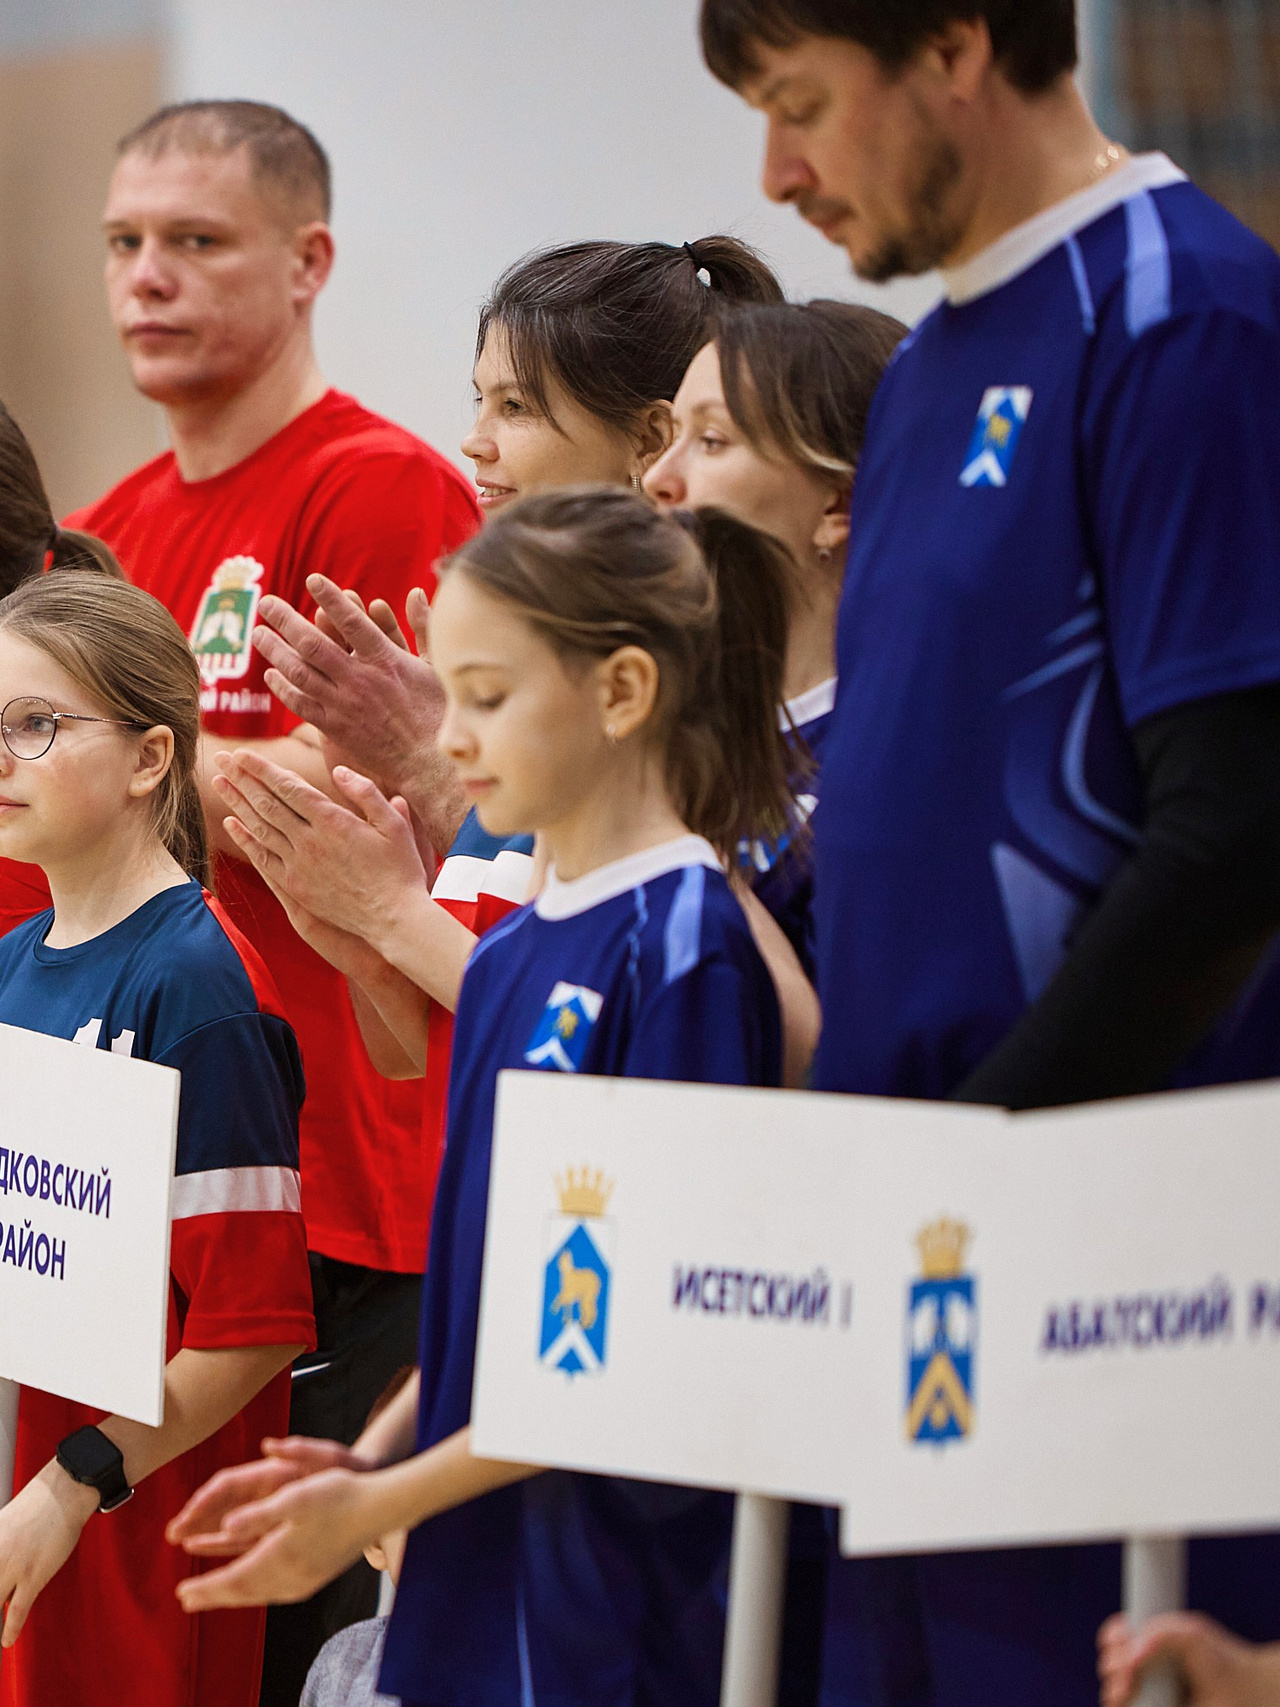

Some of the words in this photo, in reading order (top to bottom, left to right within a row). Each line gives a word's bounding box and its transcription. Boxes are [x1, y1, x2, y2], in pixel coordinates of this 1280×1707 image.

[220, 688, 271, 713] РАЙОН
[673, 1265, 831, 1325] ИСЕТСКИЙ
[1040, 1275, 1233, 1353] АБАТСКИЙ
